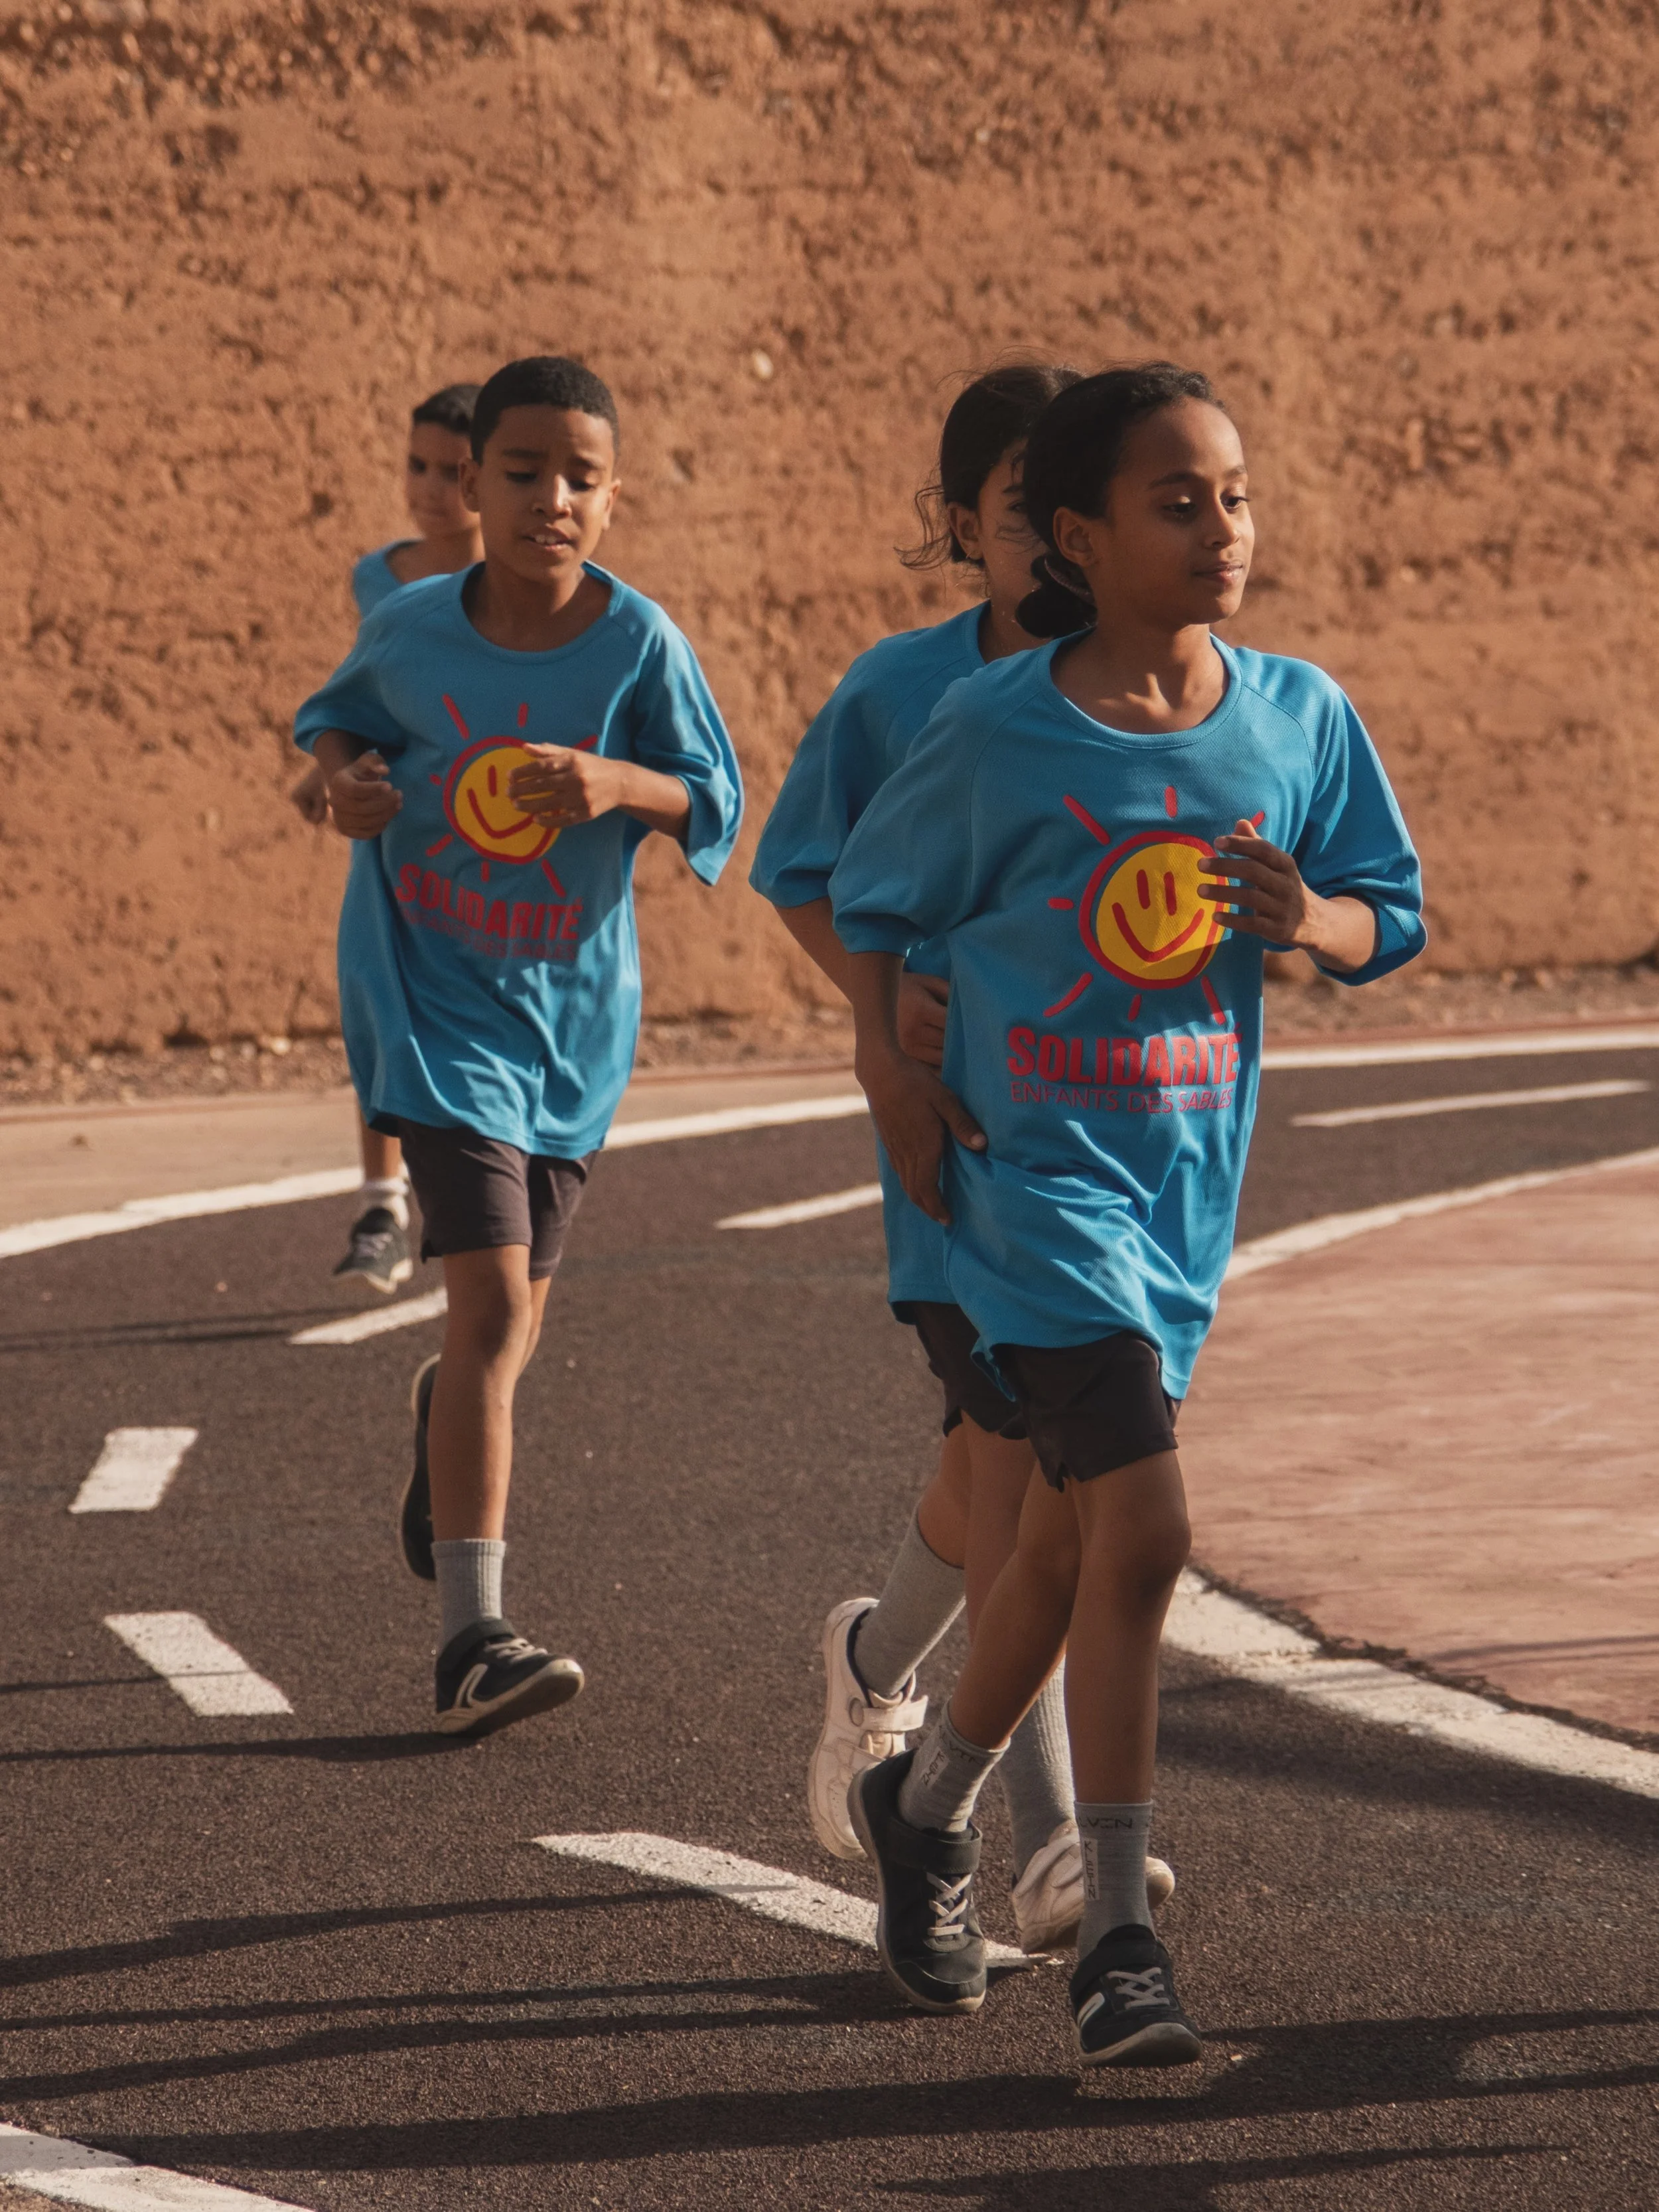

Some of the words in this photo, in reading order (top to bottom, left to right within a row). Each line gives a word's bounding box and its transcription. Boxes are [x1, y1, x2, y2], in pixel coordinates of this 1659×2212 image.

[394, 863, 584, 940] SOLIDARITÉ
[1006, 1023, 1242, 1087] SOLIDARITÉ
[1011, 1082, 1119, 1111] ENFANTS
[1127, 1091, 1174, 1114] DES
[1177, 1088, 1234, 1112] SABLES
